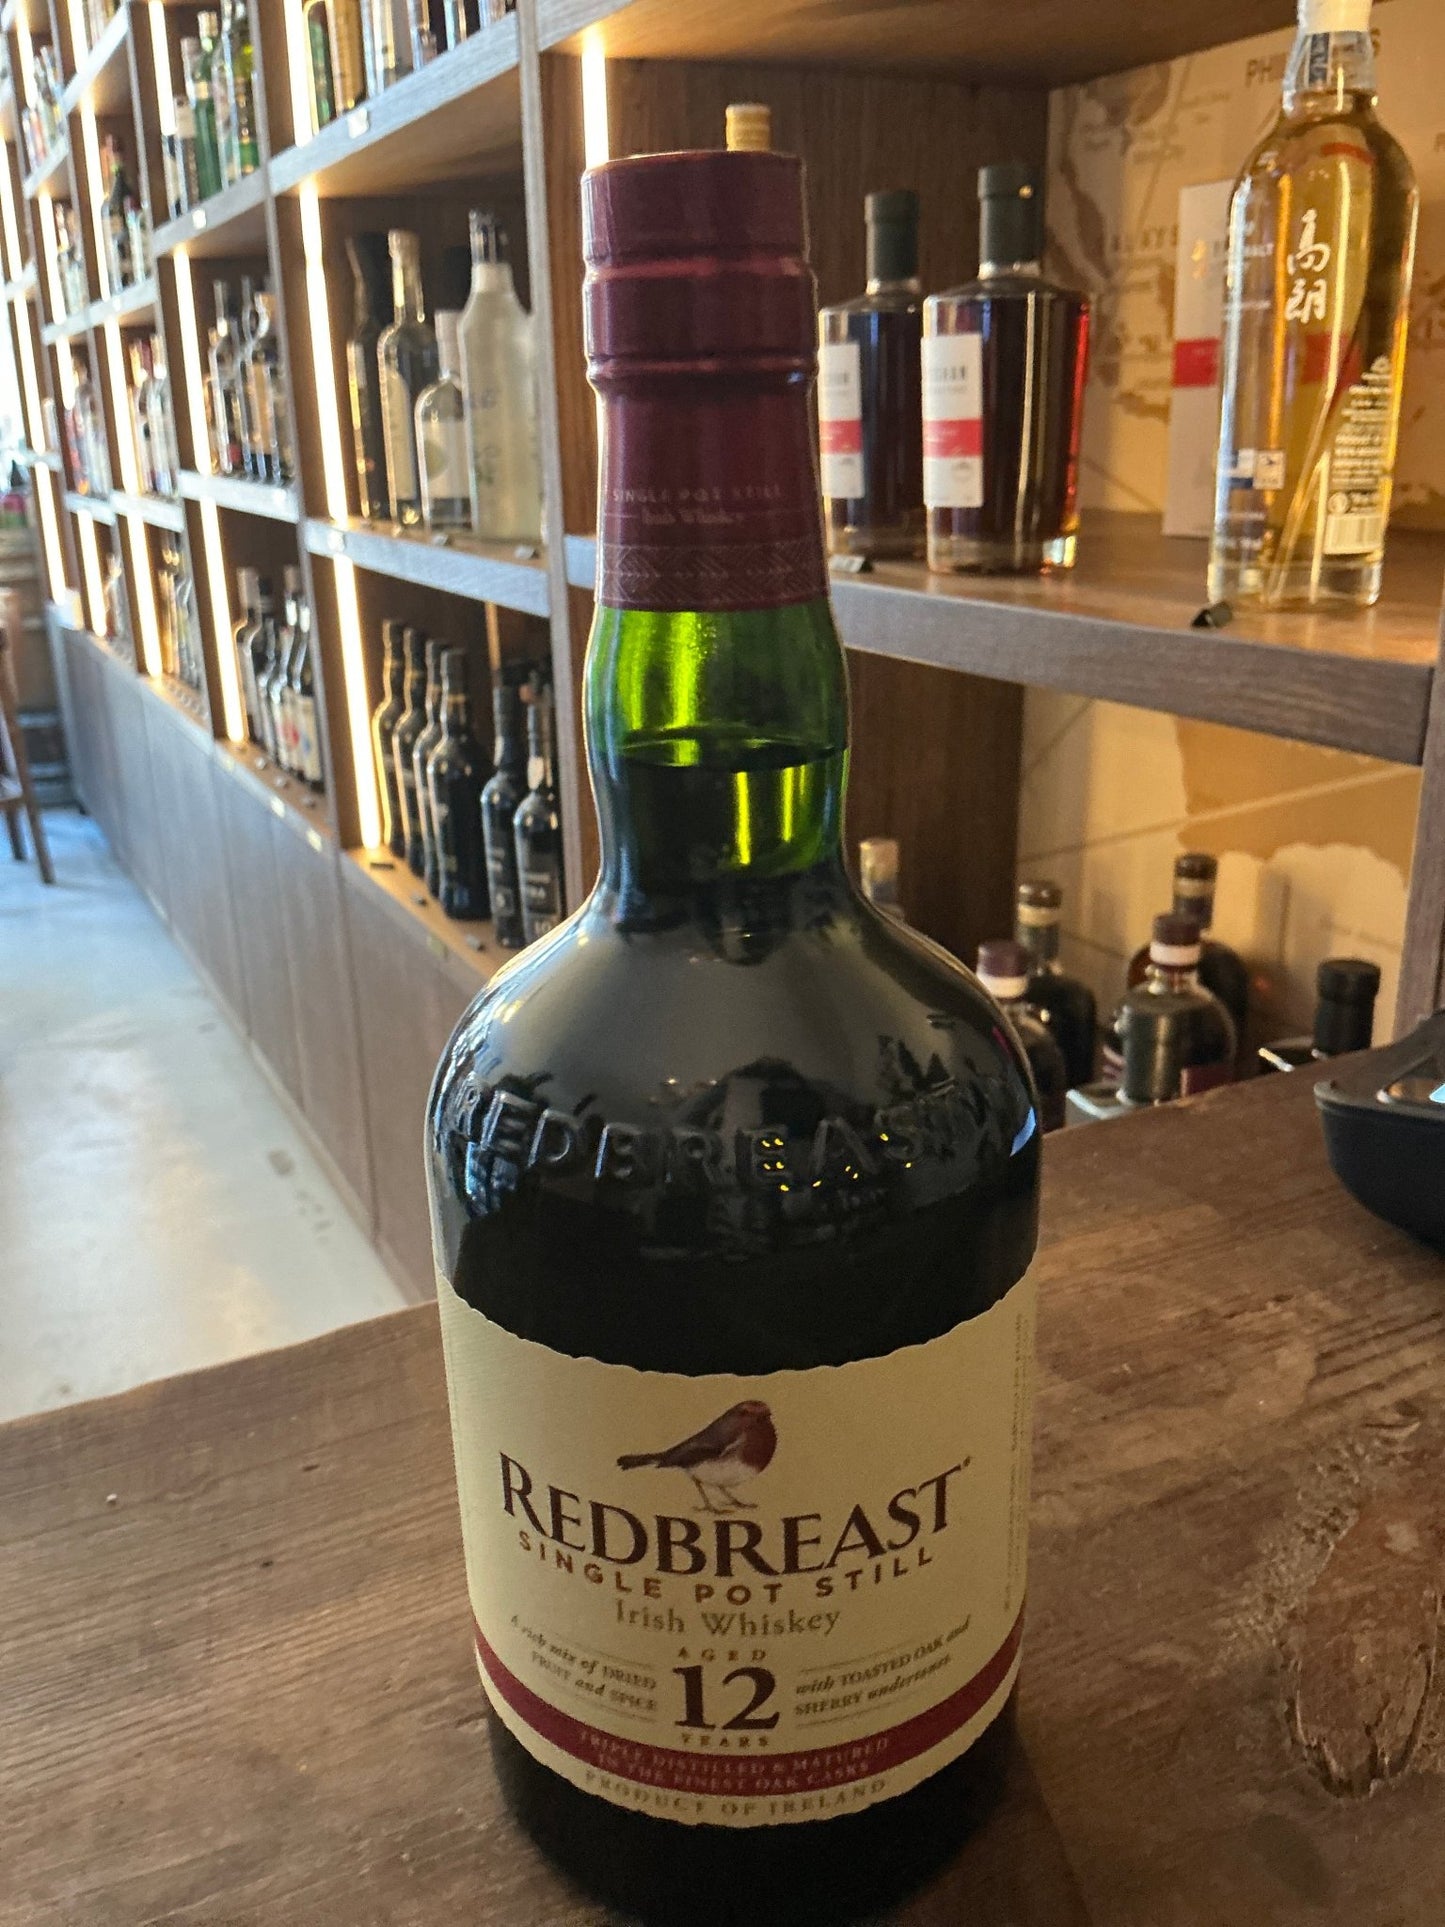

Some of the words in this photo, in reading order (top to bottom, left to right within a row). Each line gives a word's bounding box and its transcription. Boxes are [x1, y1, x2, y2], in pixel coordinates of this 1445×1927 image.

[499, 1452, 963, 1578] REDBREAST
[518, 1530, 662, 1599] SINGLE
[695, 1583, 783, 1606] POT
[816, 1547, 933, 1598] STILL
[615, 1601, 685, 1634] Irish
[699, 1607, 841, 1637] Whiskey
[678, 1646, 767, 1662] AGED
[795, 1675, 835, 1695] with
[838, 1652, 912, 1687] TOASTED
[672, 1665, 780, 1730] 12
[681, 1732, 769, 1748] YEARS
[720, 1802, 756, 1816] OF
[770, 1778, 886, 1816] IRELAND
